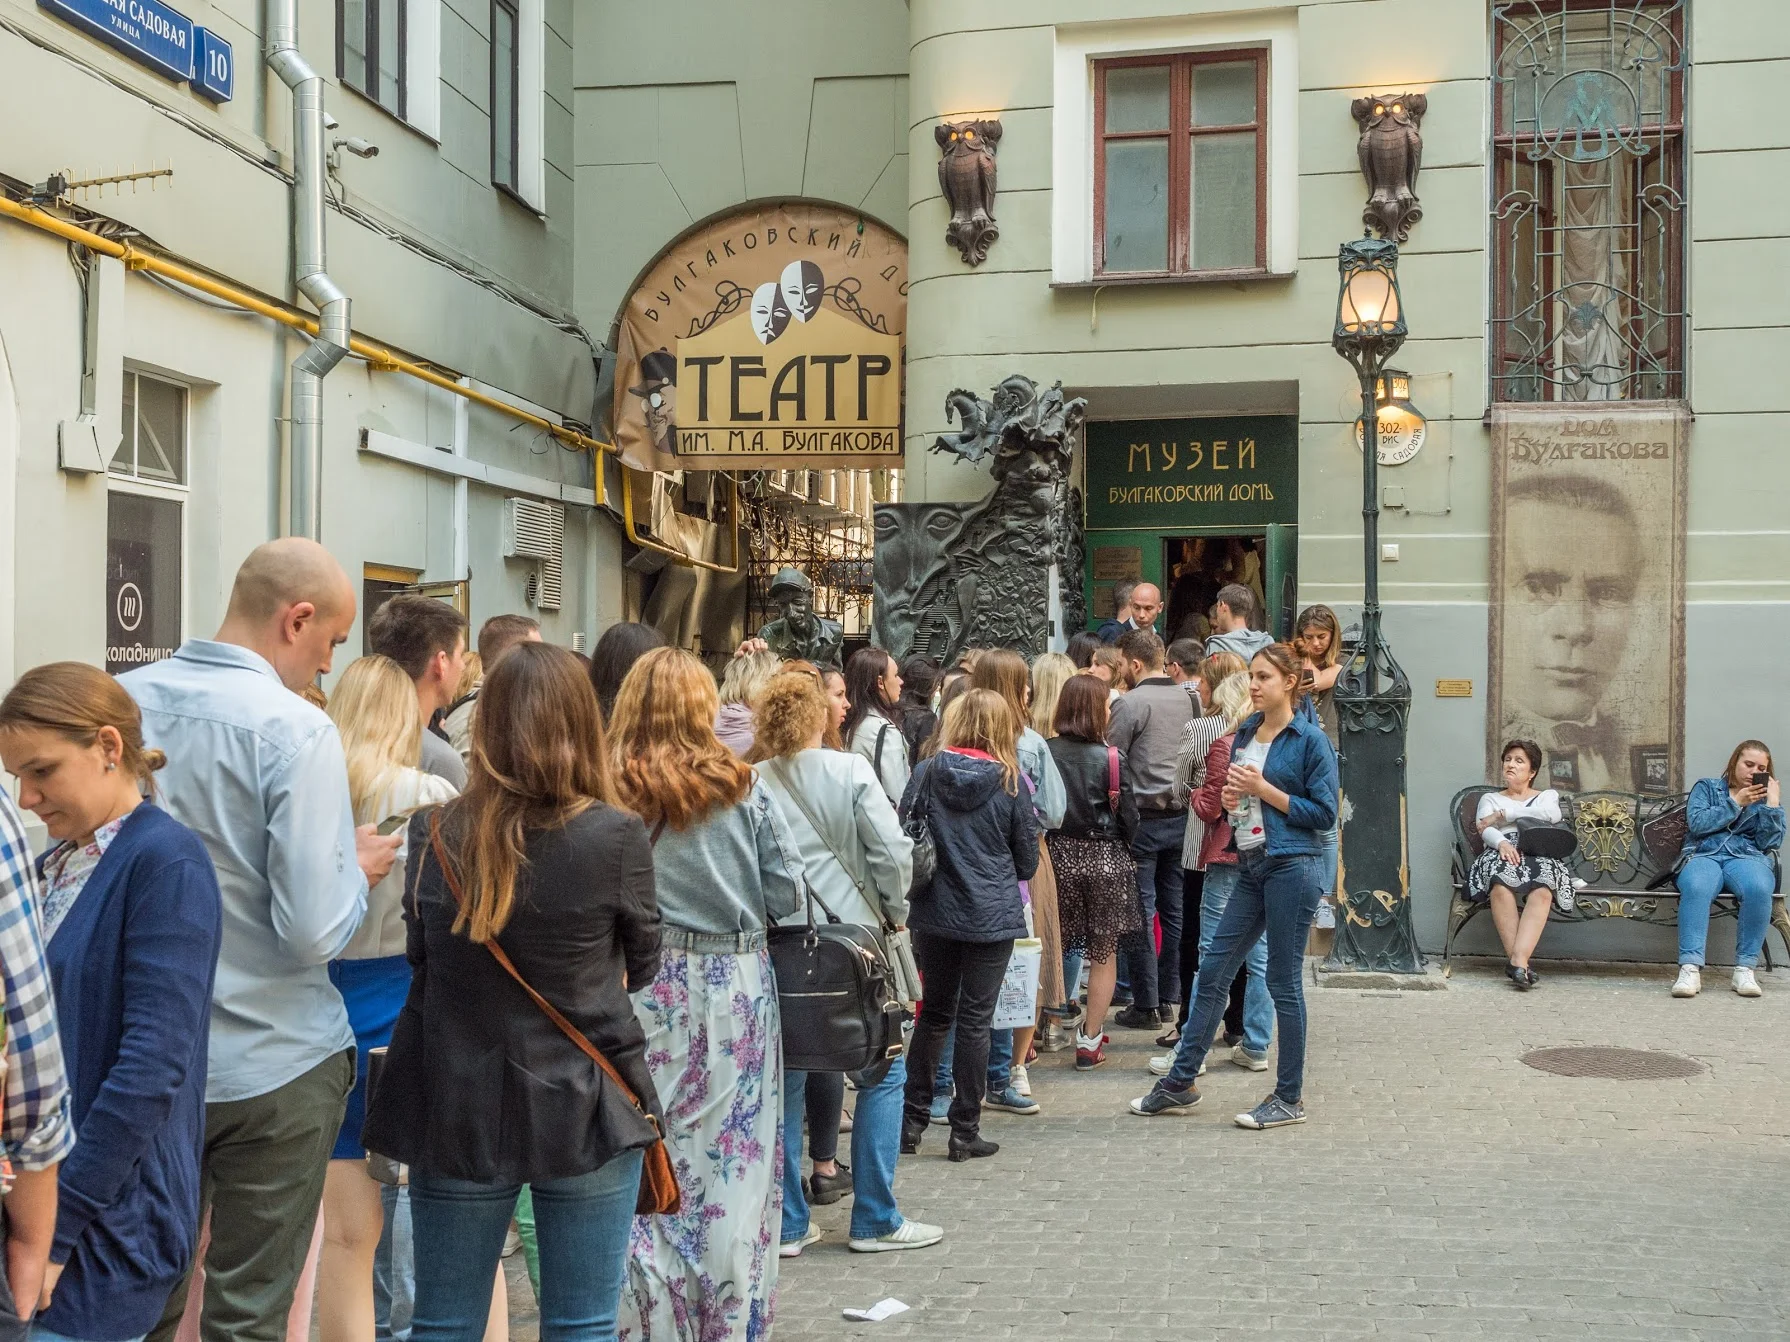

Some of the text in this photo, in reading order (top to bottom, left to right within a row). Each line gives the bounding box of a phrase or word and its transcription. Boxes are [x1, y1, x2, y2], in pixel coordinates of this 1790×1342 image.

[102, 0, 186, 50] АЯ САДОВАЯ
[110, 13, 141, 40] УЛИЦА
[209, 49, 228, 82] 10
[644, 227, 863, 322] БУЛГАКОВСКИЙ
[684, 353, 892, 422] ТЕАТР
[680, 430, 894, 453] ИМ. М.А. БУЛГАКОВА
[1127, 437, 1256, 473] МУЗЕЙ
[1393, 428, 1422, 460] САДОВАЯ
[1109, 483, 1275, 504] БУЛГАКОВСКИЙ ДОМЪ
